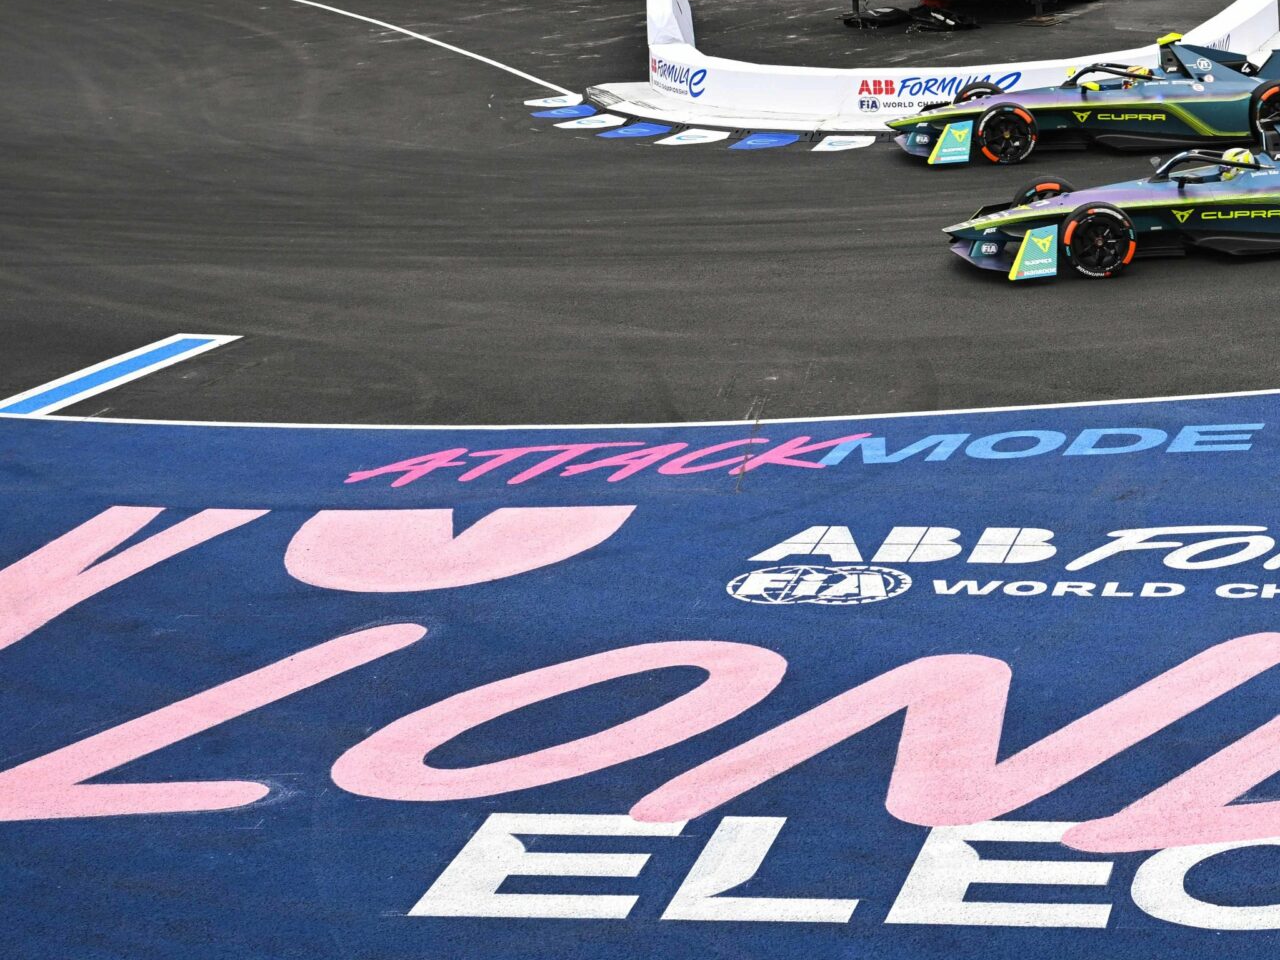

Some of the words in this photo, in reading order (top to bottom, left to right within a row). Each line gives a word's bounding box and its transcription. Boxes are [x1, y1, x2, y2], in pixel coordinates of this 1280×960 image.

[1241, 63, 1251, 73] 4
[858, 79, 896, 96] ABB
[1097, 113, 1167, 121] CUPRA
[747, 525, 1057, 564] ABB
[932, 579, 1188, 598] WORLD
